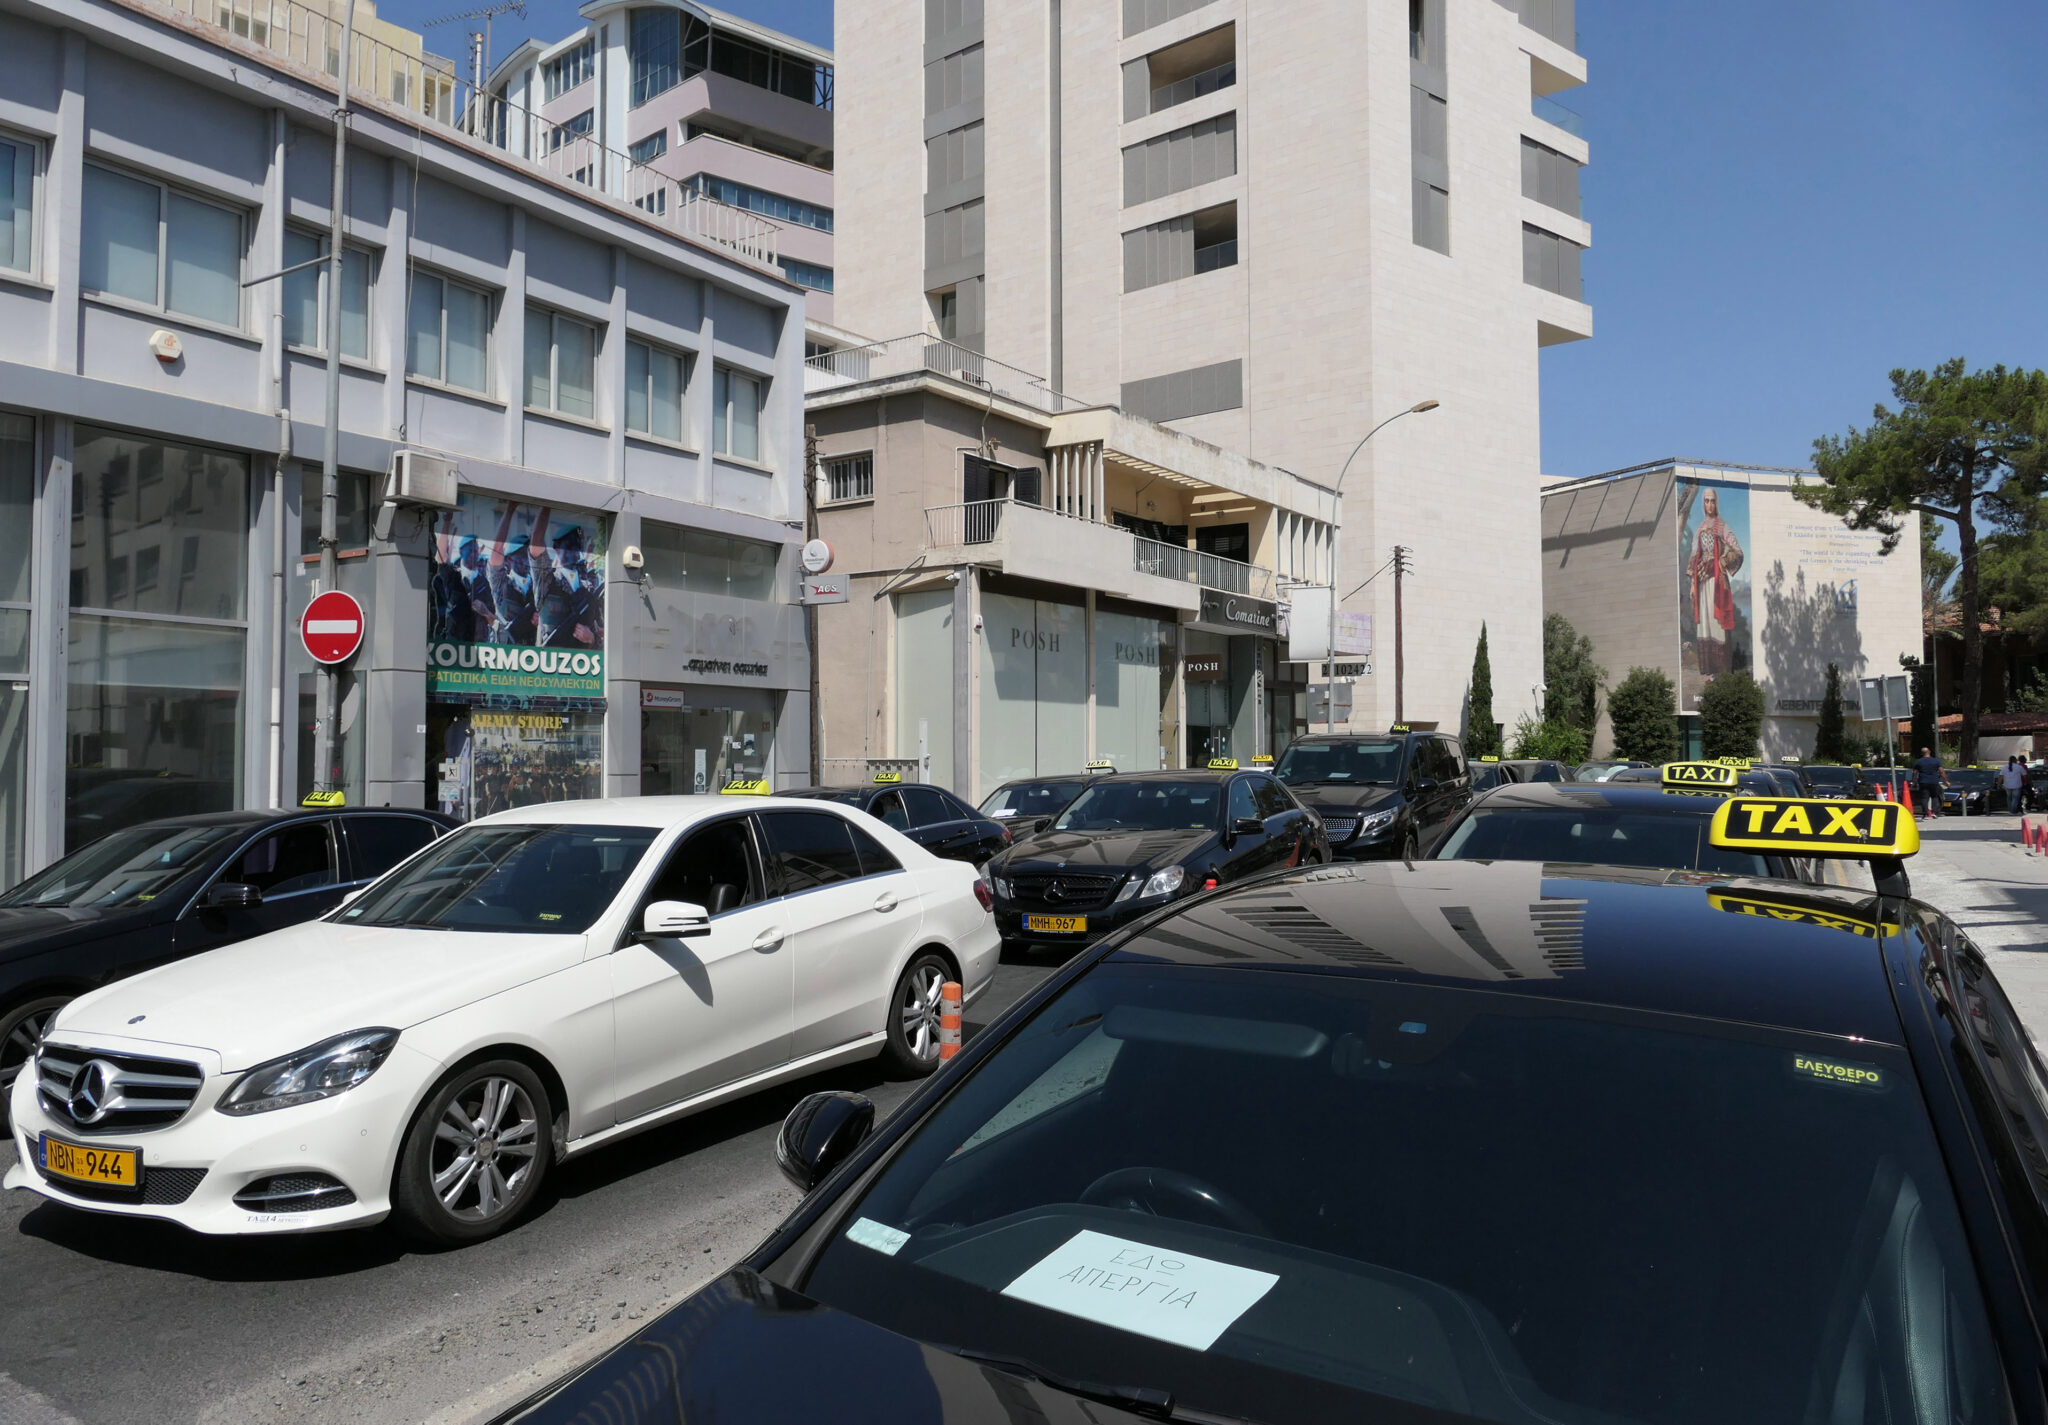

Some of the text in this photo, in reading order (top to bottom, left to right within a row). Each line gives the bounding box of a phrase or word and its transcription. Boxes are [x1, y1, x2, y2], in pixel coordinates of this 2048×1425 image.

[1226, 599, 1270, 627] Comarine
[1011, 628, 1059, 652] POSH
[1115, 642, 1155, 664] POSH
[1188, 663, 1218, 671] POSH
[1322, 664, 1372, 675] 2102422
[491, 674, 516, 686] ΕΙΔΗ
[520, 676, 600, 689] ΝΕΟΣΥΛΛΕΚΤΩΝ
[471, 714, 563, 729] ARMY STORE
[1671, 766, 1725, 782] TAXI
[729, 780, 761, 789] TAXI
[310, 791, 336, 800] TAXI
[1740, 804, 1886, 838] TAXI
[1030, 917, 1050, 929] MMH
[1055, 918, 1076, 929] 967
[1795, 1058, 1879, 1082] ΕΛΕΥΘΕΡΟ
[49, 1141, 75, 1173] NBN
[86, 1151, 122, 1179] 944
[1058, 1265, 1198, 1309] ΑΠΕΡΓΙΑ
